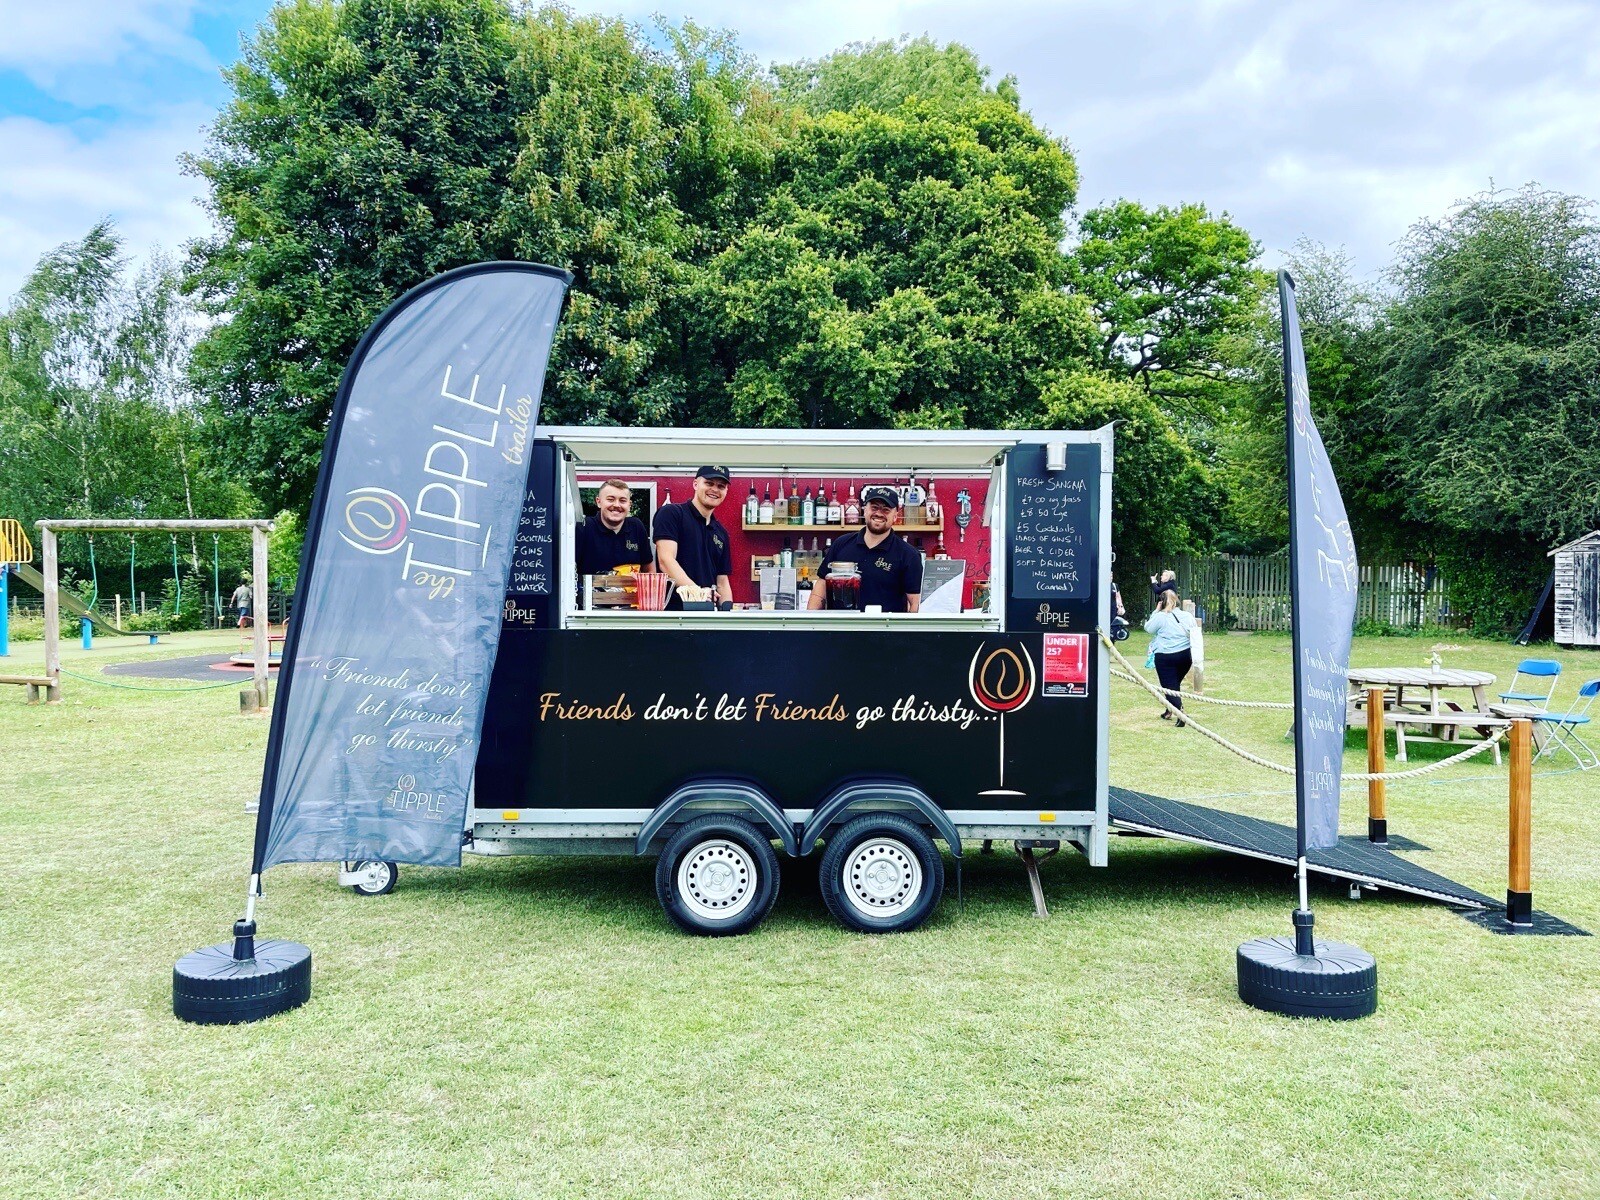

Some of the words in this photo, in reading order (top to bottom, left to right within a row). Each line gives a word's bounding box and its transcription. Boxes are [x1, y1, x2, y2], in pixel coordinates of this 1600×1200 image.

[502, 393, 533, 466] trailer
[402, 364, 506, 580] TIPPLE
[1017, 477, 1044, 488] FRESH
[1017, 521, 1030, 533] £5
[1015, 535, 1036, 543] LOADS
[1052, 535, 1072, 543] GINS
[520, 546, 543, 556] GINS
[1015, 545, 1033, 554] BEER
[1036, 546, 1045, 555] &
[1049, 547, 1075, 557] CIDER
[515, 559, 545, 568] CIDER
[1040, 558, 1074, 570] DRINKS
[514, 571, 547, 582] DRINKS
[1051, 570, 1079, 582] WATER
[413, 571, 456, 600] the
[516, 581, 549, 594] WATER
[503, 608, 536, 621] TIPPLE
[1037, 611, 1070, 624] TIPPLE
[1046, 637, 1078, 646] UNDER
[1046, 647, 1062, 656] 25?
[417, 673, 474, 698] don't
[356, 693, 387, 715] let
[384, 697, 464, 727] friends
[540, 692, 636, 721] Friends
[643, 693, 709, 721] don't
[714, 693, 747, 721] let
[754, 693, 850, 722] Friends
[856, 703, 886, 730] go
[346, 732, 378, 755] go
[391, 789, 447, 813] TIPPLE
